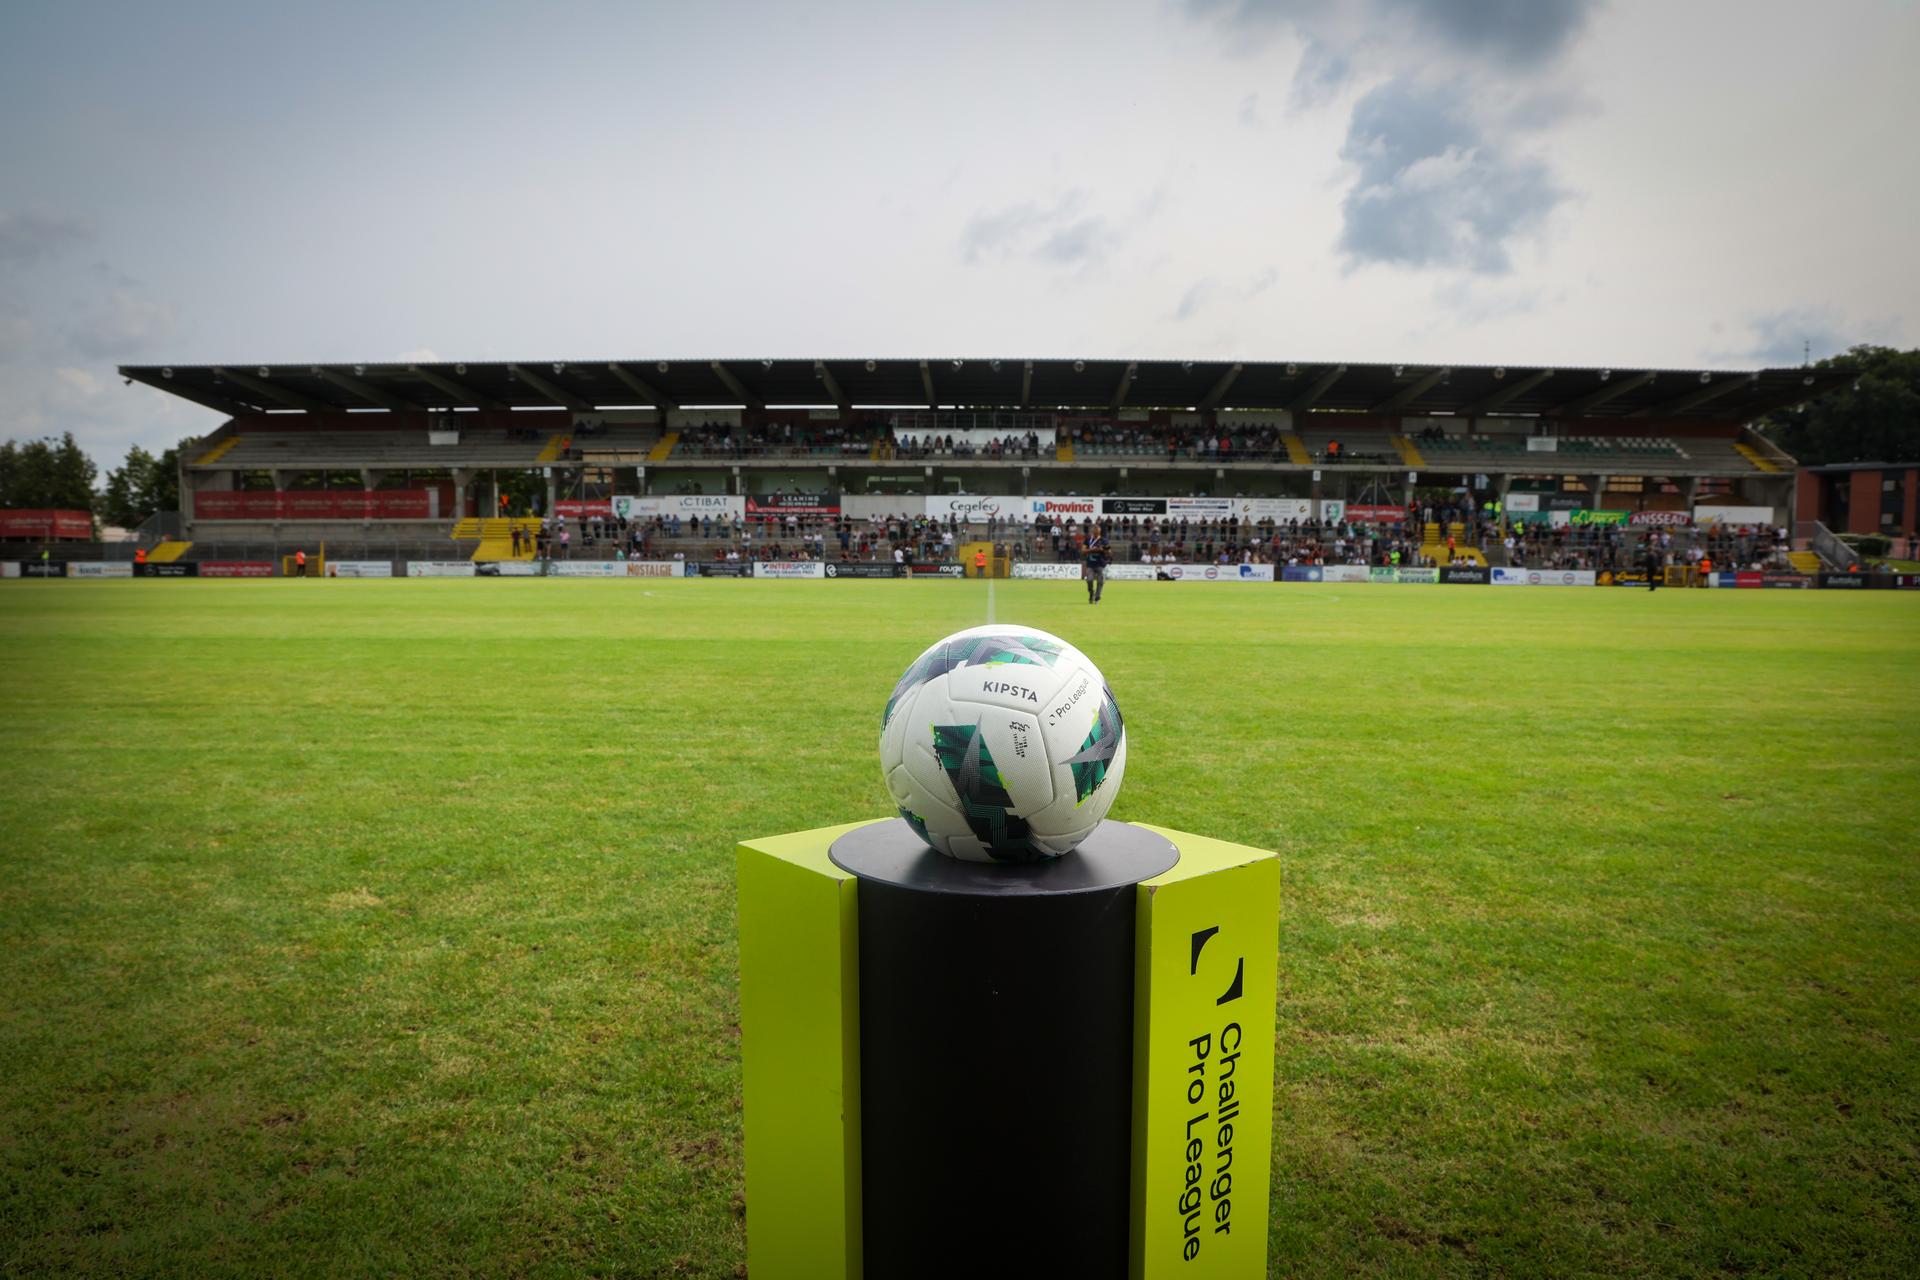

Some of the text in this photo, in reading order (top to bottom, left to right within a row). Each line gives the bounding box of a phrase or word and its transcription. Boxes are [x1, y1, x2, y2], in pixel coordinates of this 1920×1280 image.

[950, 500, 995, 513] Cegelec
[1033, 501, 1094, 513] LaProvince
[627, 562, 672, 577] NOSTALGIE
[939, 565, 963, 575] rouge
[983, 681, 1038, 702] KIPSTA
[1055, 678, 1089, 718] Pro League
[1209, 1022, 1242, 1235] Challenger
[1178, 1033, 1212, 1262] Pro League
